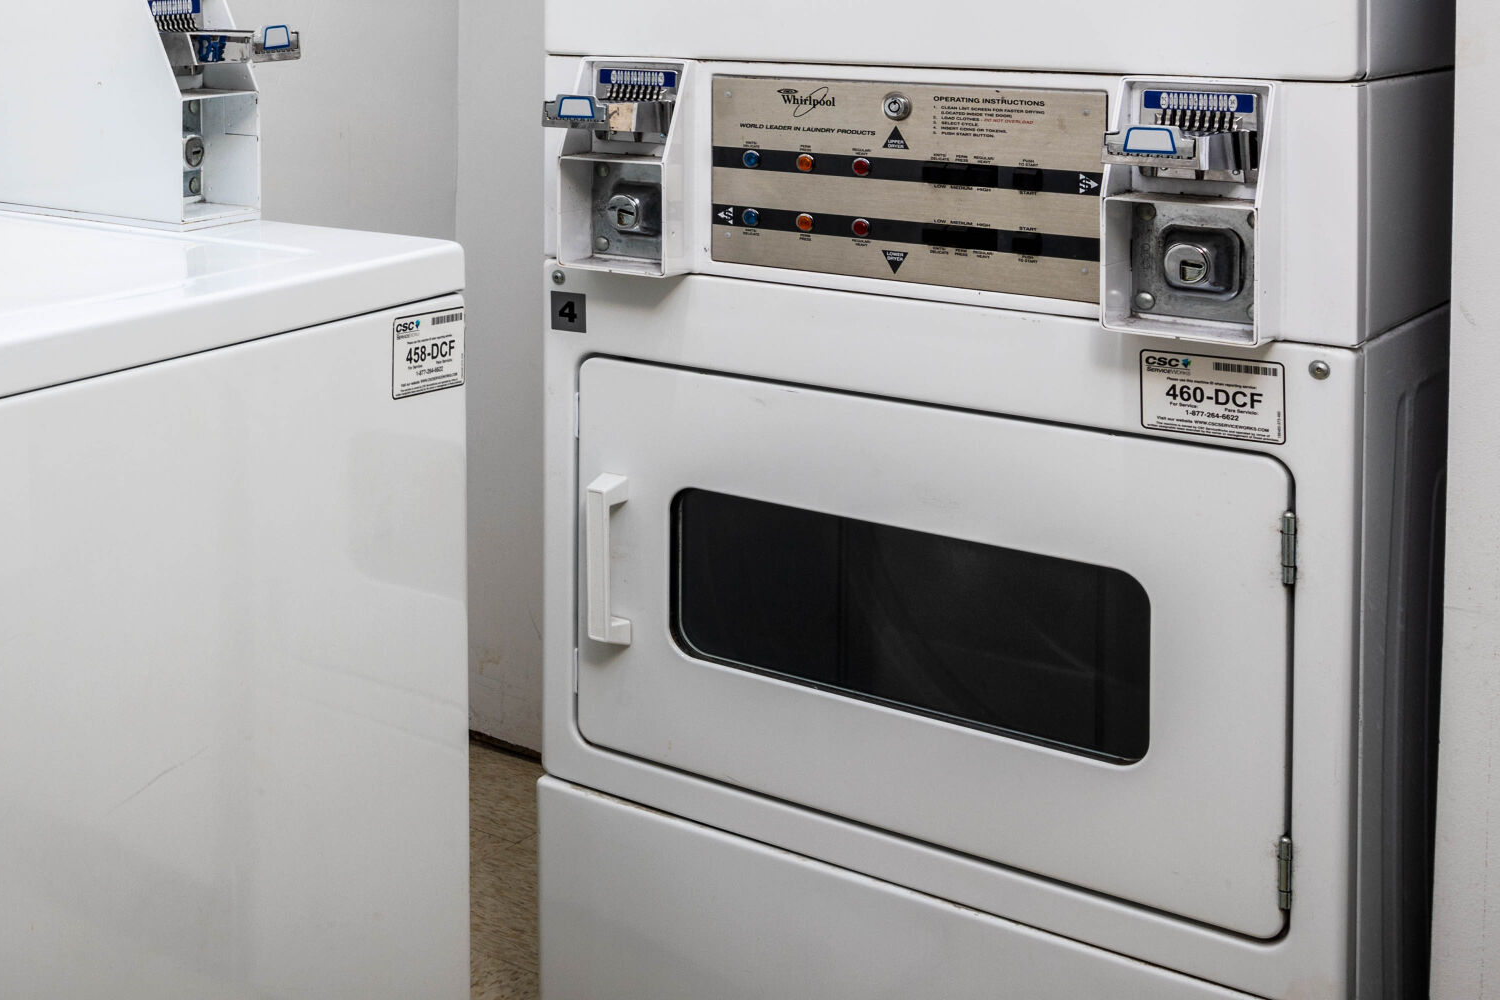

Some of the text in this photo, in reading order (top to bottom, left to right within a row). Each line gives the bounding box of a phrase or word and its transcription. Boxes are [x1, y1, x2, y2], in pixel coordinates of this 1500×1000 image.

[781, 94, 836, 109] Whirlpool
[933, 95, 1046, 107] OPERATING INSTRUCTIONS
[802, 126, 836, 134] LAUNDRY
[836, 128, 876, 136] PRODUCTS
[558, 300, 578, 324] 4
[395, 321, 415, 333] CSC
[405, 339, 456, 364] 458-DCF
[1145, 355, 1180, 368] CSC
[1165, 383, 1263, 409] 460-DCF
[1185, 409, 1240, 422] 1-877-264-6622
